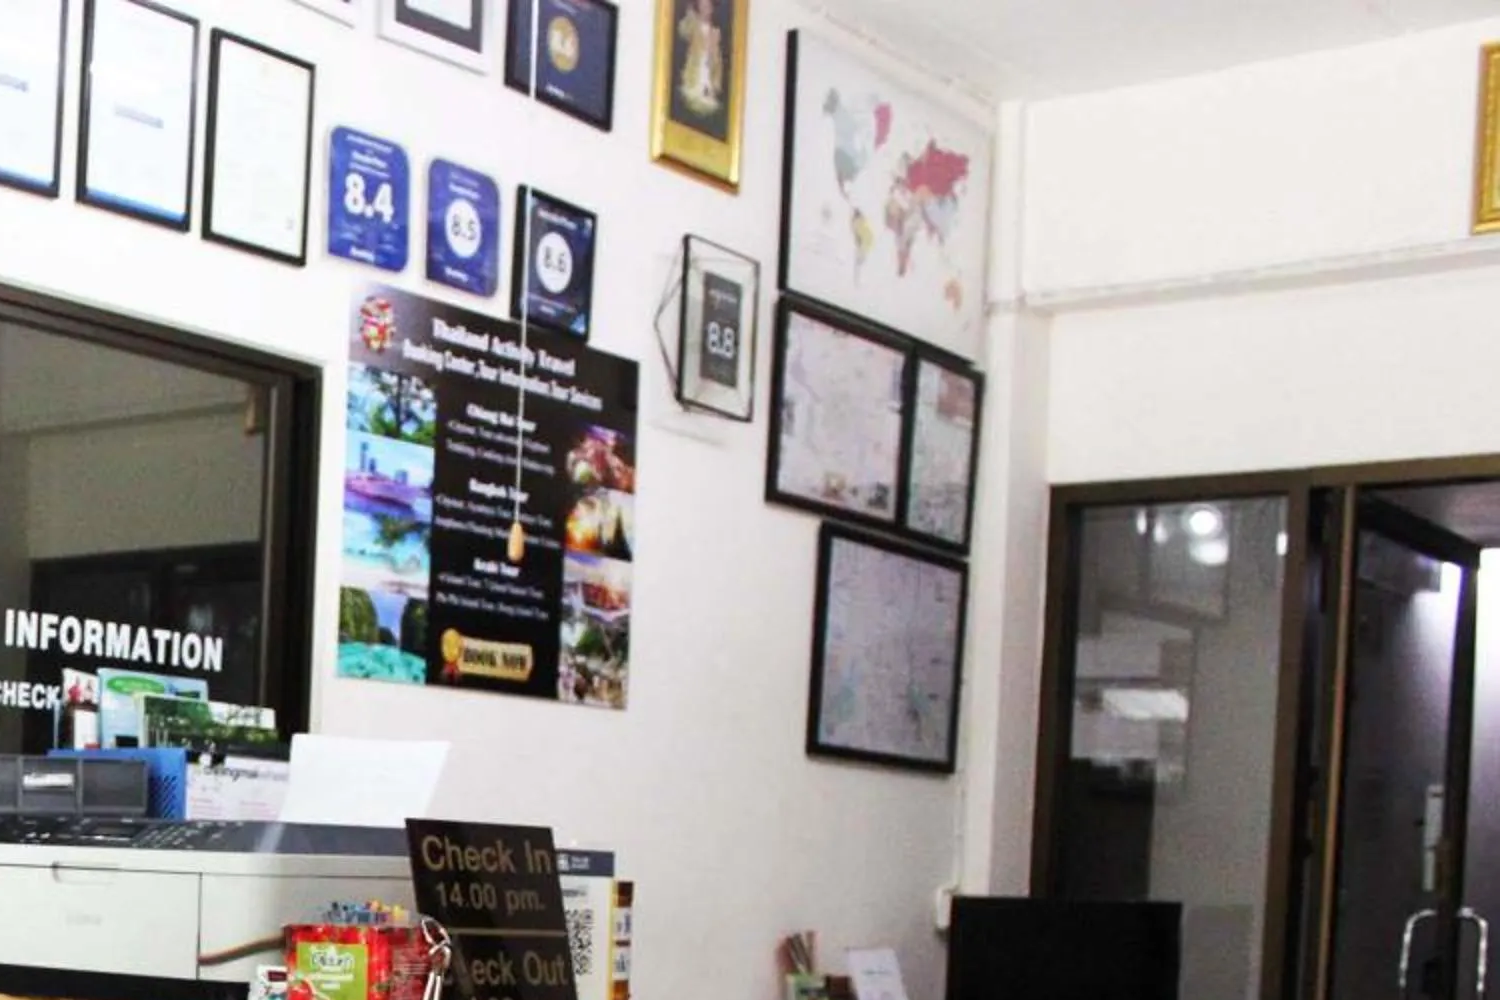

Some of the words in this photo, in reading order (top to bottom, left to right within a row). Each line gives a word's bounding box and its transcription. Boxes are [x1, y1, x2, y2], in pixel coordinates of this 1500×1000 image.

[343, 172, 395, 223] 8.4
[451, 213, 476, 241] 8.5
[707, 320, 735, 360] 8.8
[4, 608, 224, 672] INFORMATION
[421, 835, 516, 873] Check
[525, 840, 551, 875] In
[436, 881, 496, 909] 14.00
[506, 888, 546, 915] pm.
[523, 950, 570, 986] Out
